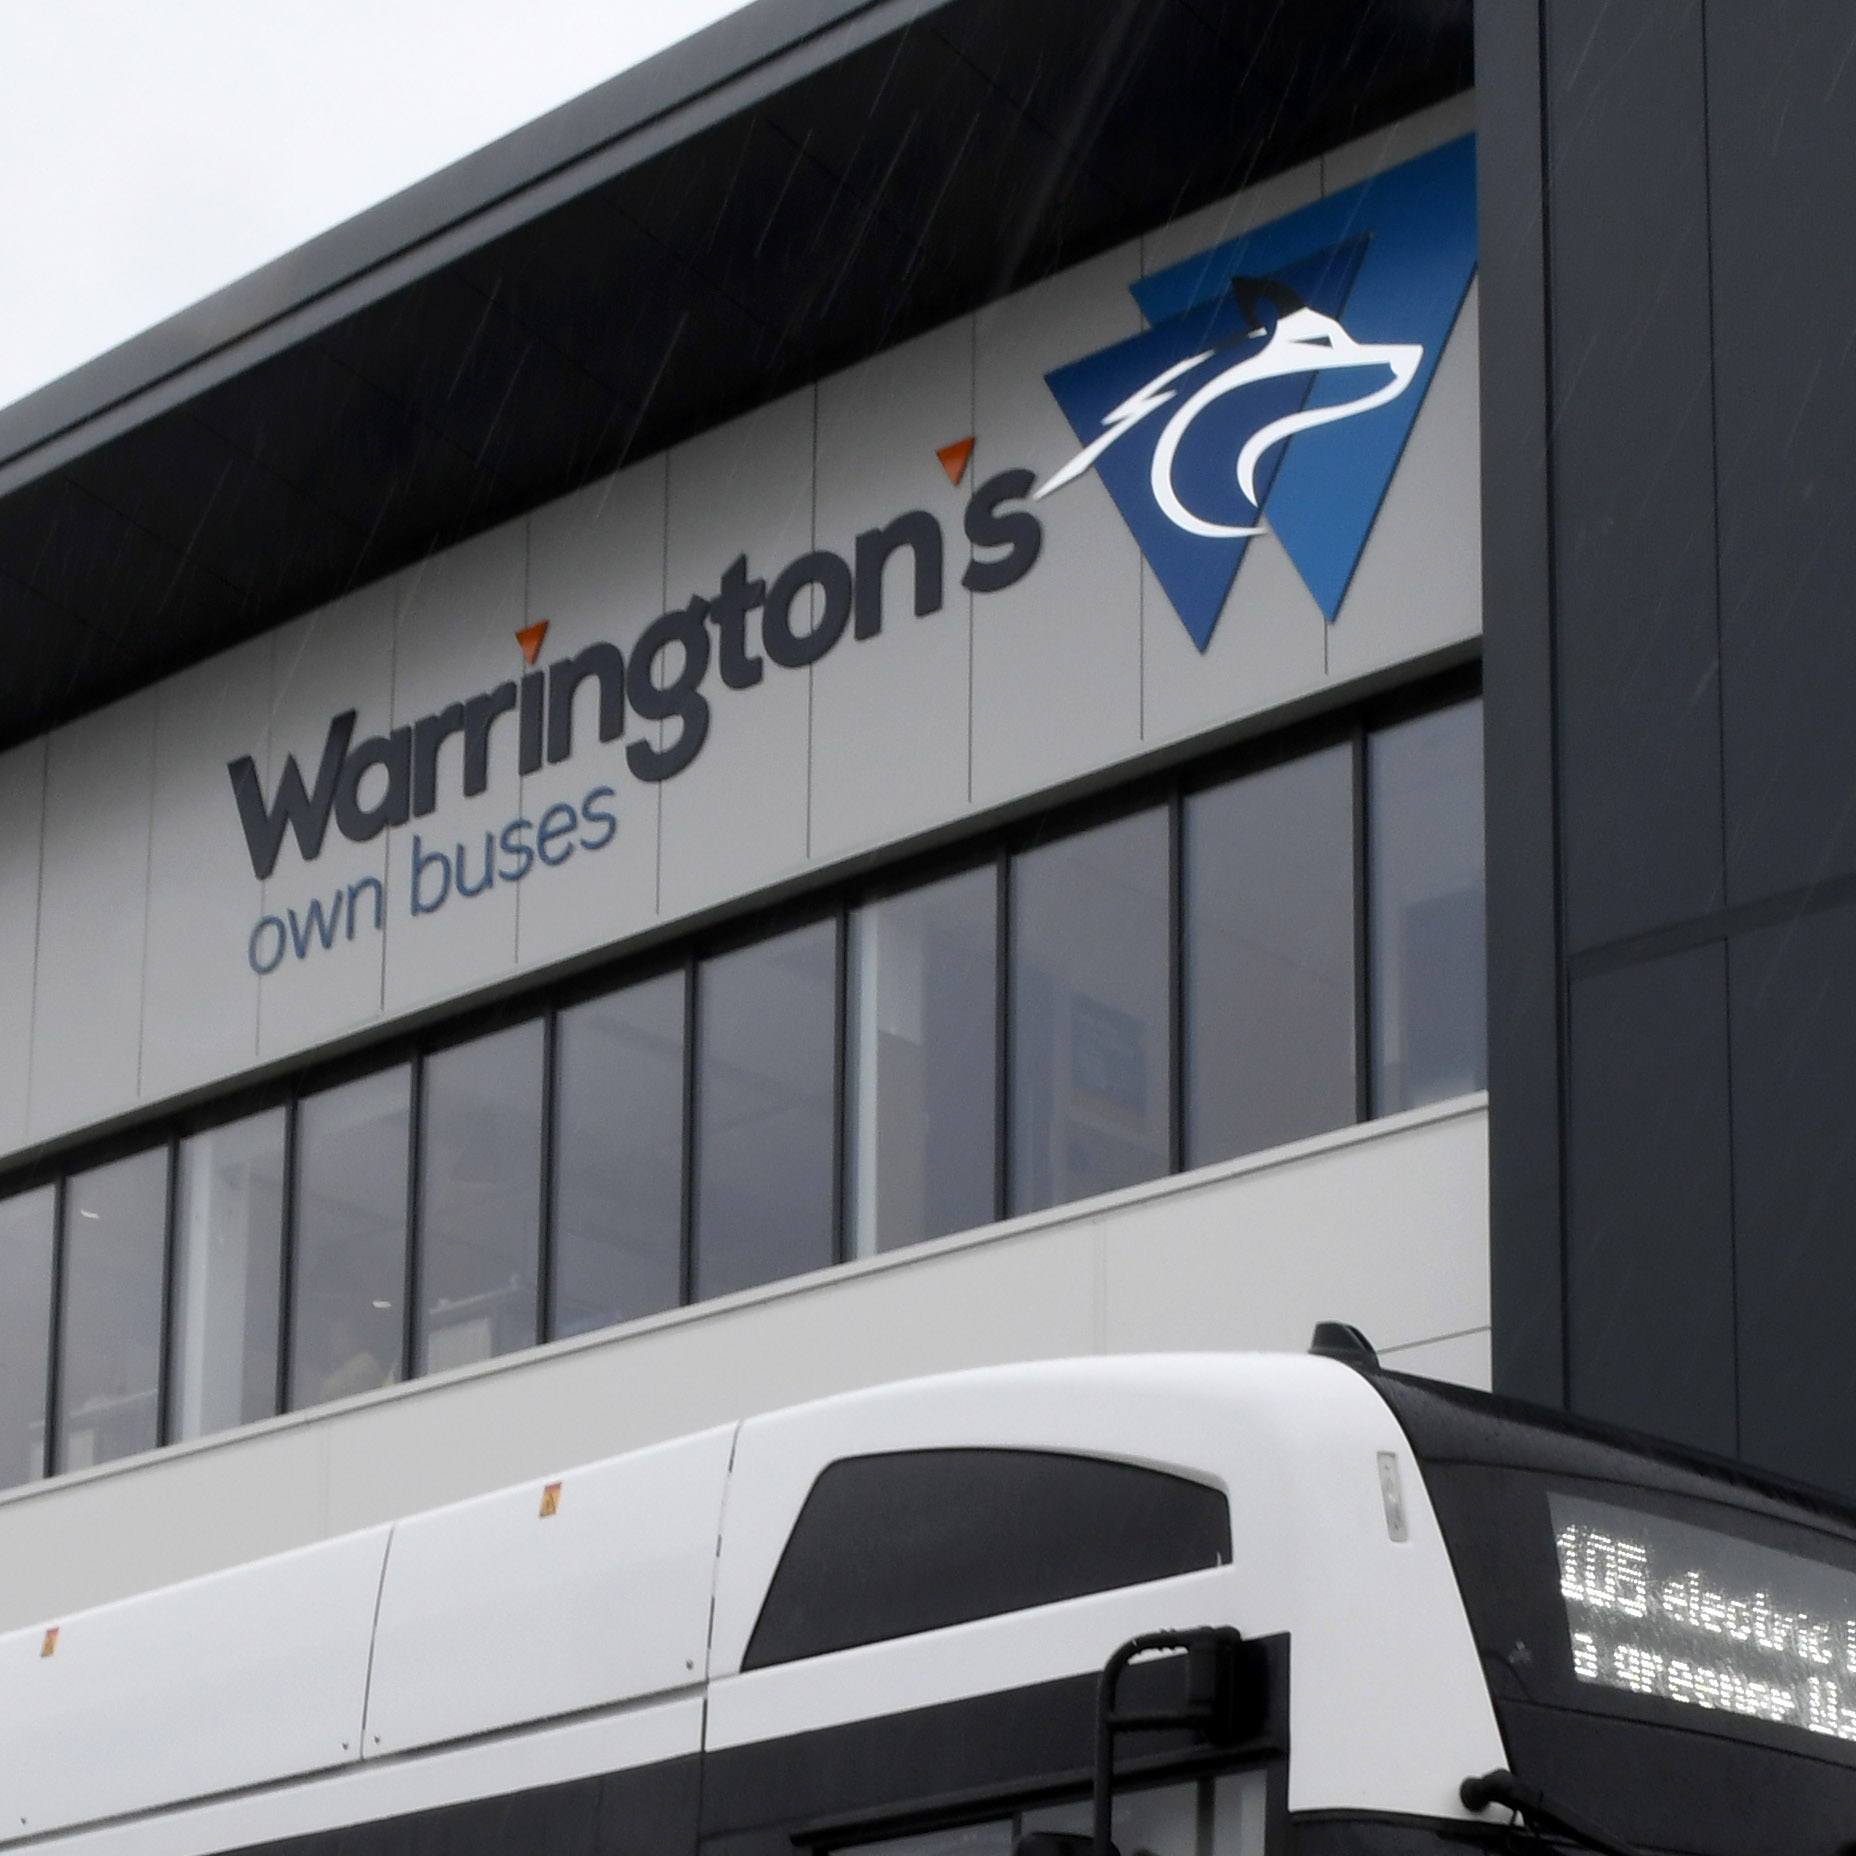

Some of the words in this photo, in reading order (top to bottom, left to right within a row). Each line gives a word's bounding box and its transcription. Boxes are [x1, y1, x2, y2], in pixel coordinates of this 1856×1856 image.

[227, 436, 1043, 880] Warrington's
[248, 873, 383, 975] own
[410, 785, 619, 918] buses
[1557, 1525, 1646, 1618] 105
[1662, 1571, 1832, 1665] electric
